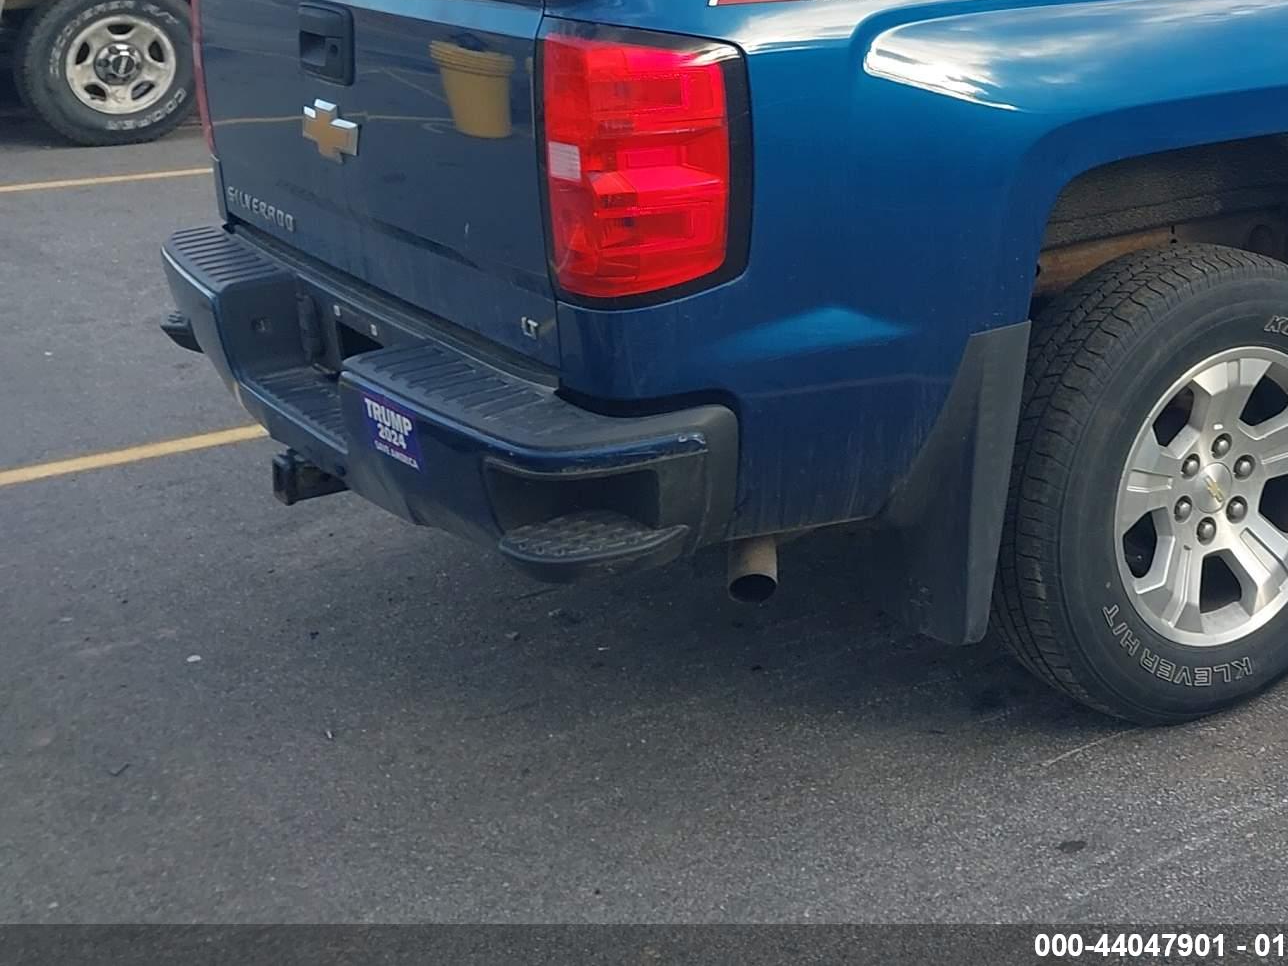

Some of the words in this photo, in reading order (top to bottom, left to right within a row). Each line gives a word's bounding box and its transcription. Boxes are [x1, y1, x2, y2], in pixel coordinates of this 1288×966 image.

[227, 186, 294, 232] SILVERADO
[521, 316, 539, 340] LT
[364, 397, 413, 436] TRUMP
[377, 423, 407, 449] 2024
[1140, 652, 1254, 686] KLEVER
